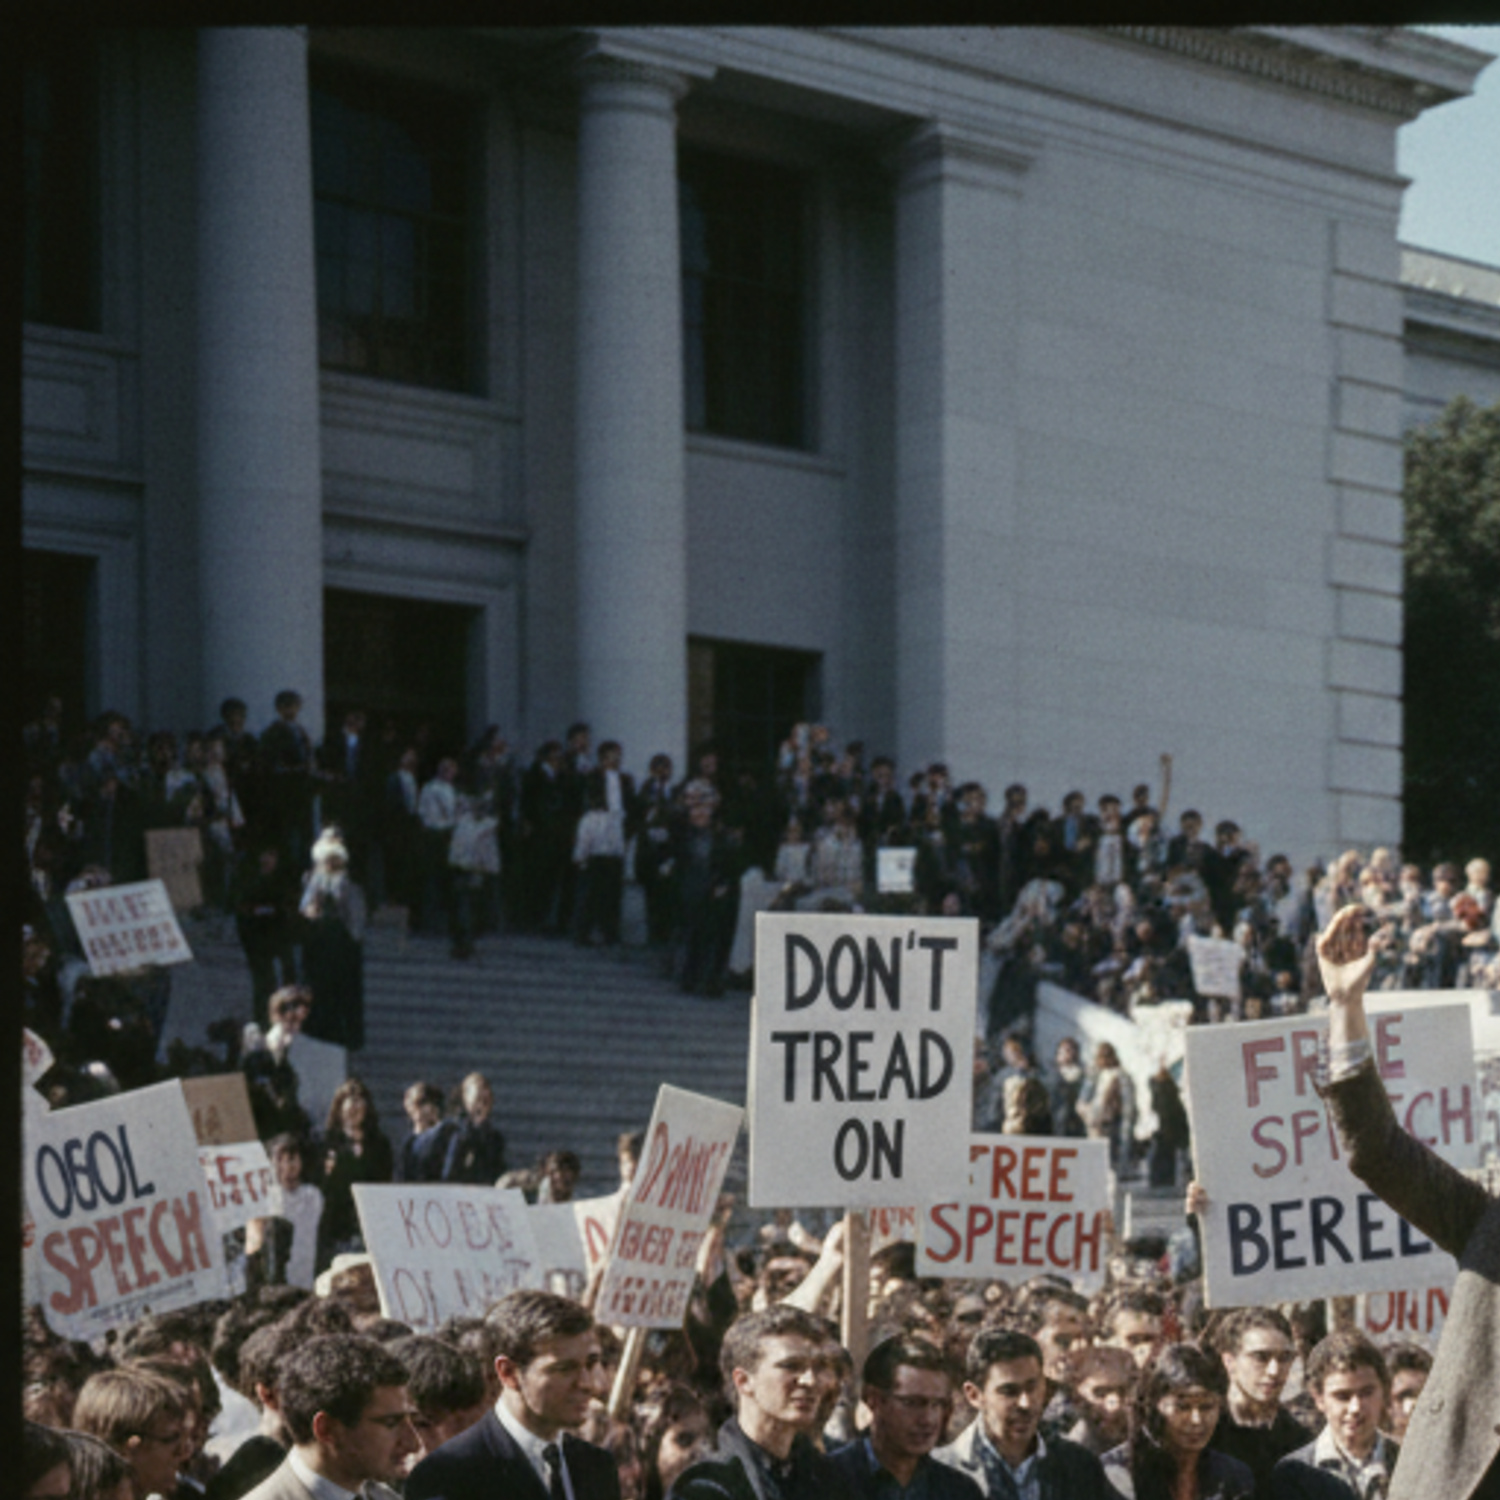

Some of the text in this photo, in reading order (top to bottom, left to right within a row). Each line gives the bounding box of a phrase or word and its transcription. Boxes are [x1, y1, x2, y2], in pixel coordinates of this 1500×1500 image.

[785, 929, 958, 1011] DON'T
[770, 1029, 955, 1102] TREAD
[1242, 1014, 1406, 1109] FRE
[834, 1118, 905, 1181] ON
[42, 1190, 211, 1316] SPEECH
[925, 1203, 1101, 1272] SPEECH
